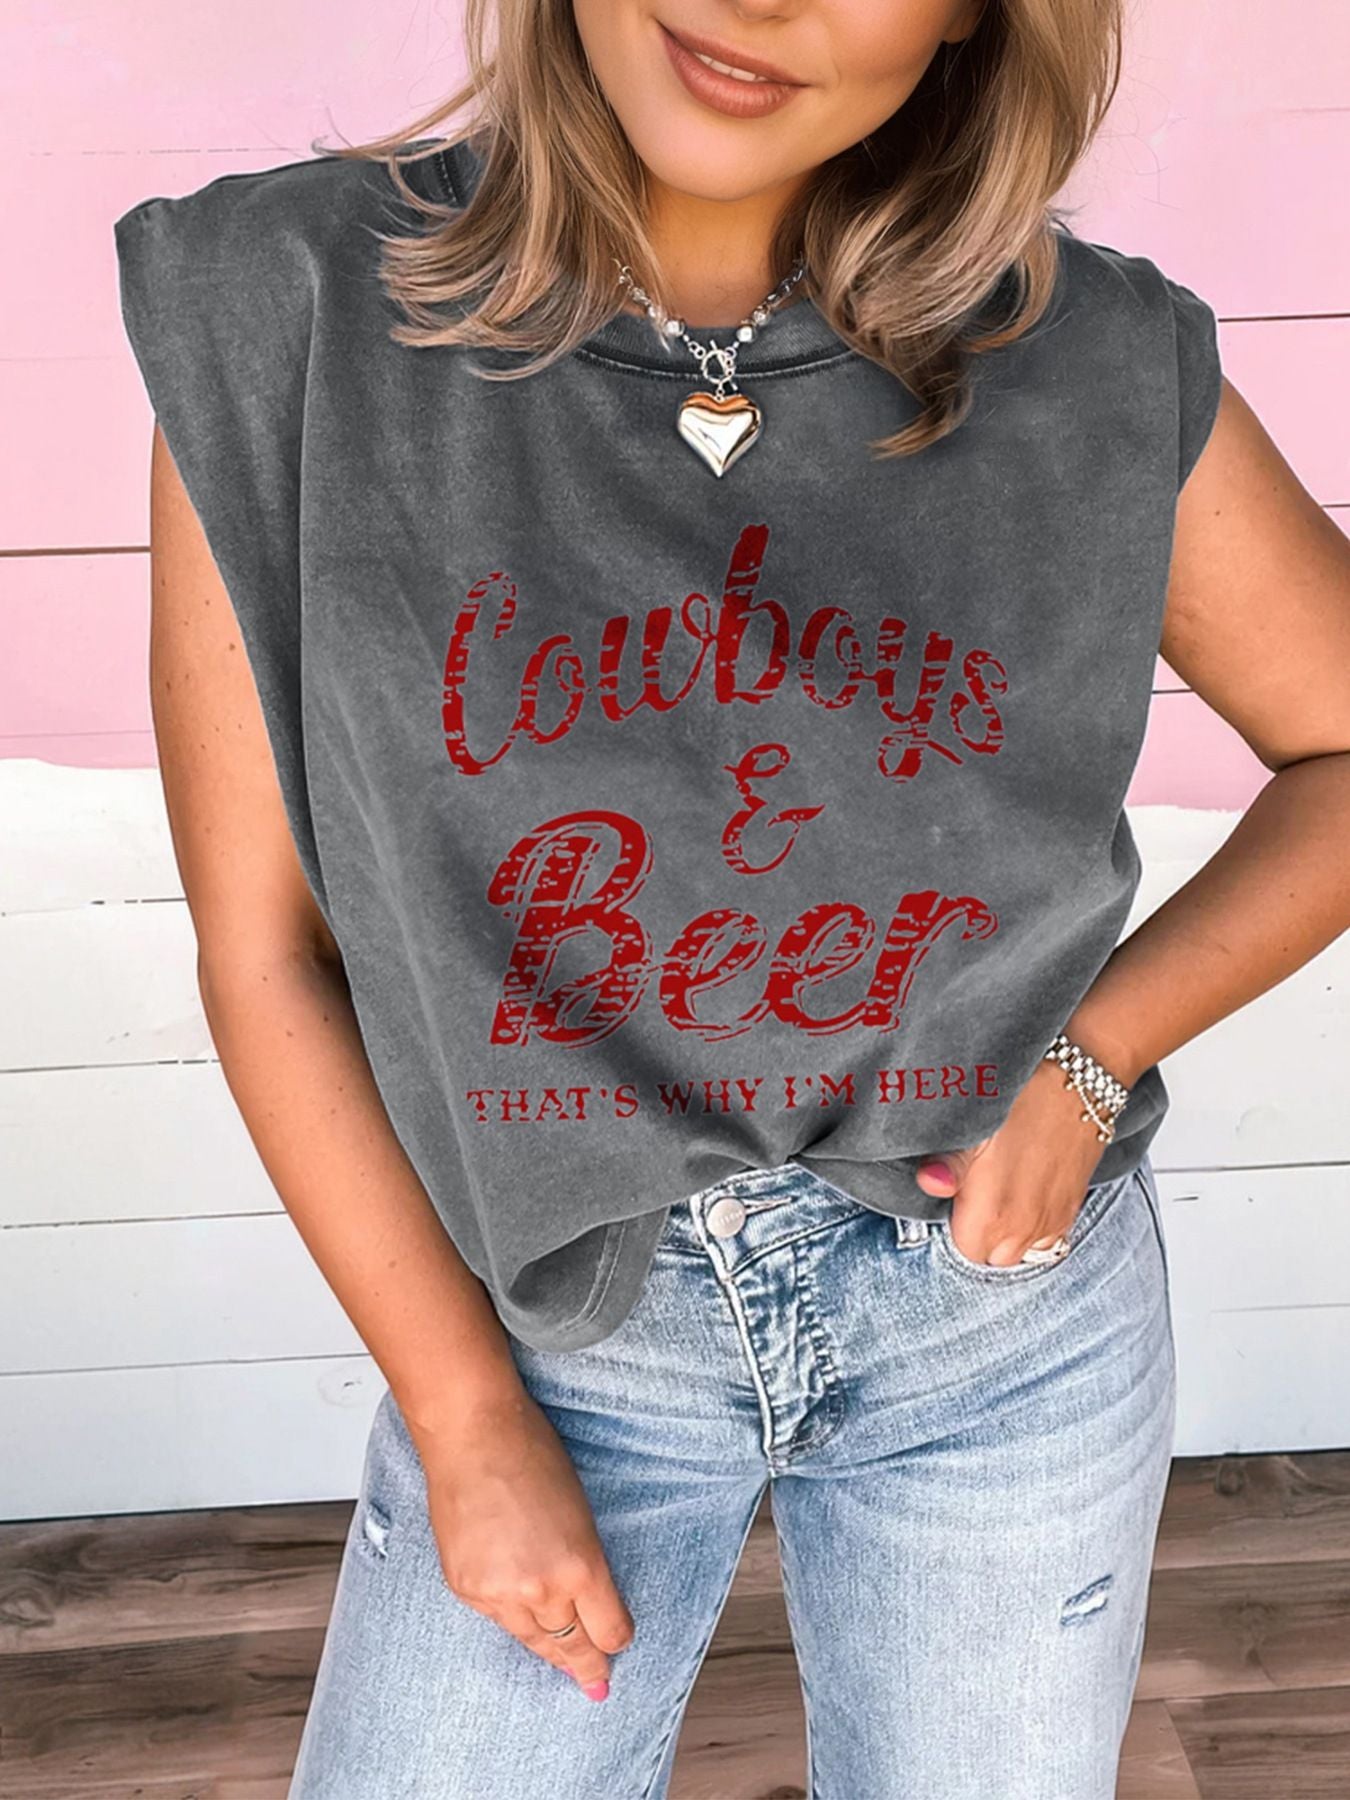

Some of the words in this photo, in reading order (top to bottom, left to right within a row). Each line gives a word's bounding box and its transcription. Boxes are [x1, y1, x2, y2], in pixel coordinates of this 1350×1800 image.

[442, 524, 1008, 782] Cowboys
[722, 741, 825, 874] &
[488, 810, 998, 1048] Beer
[467, 1084, 638, 1123] THAT'S
[657, 1077, 763, 1115] WHY
[784, 1073, 857, 1109] I'M
[877, 1064, 1000, 1104] HERE
